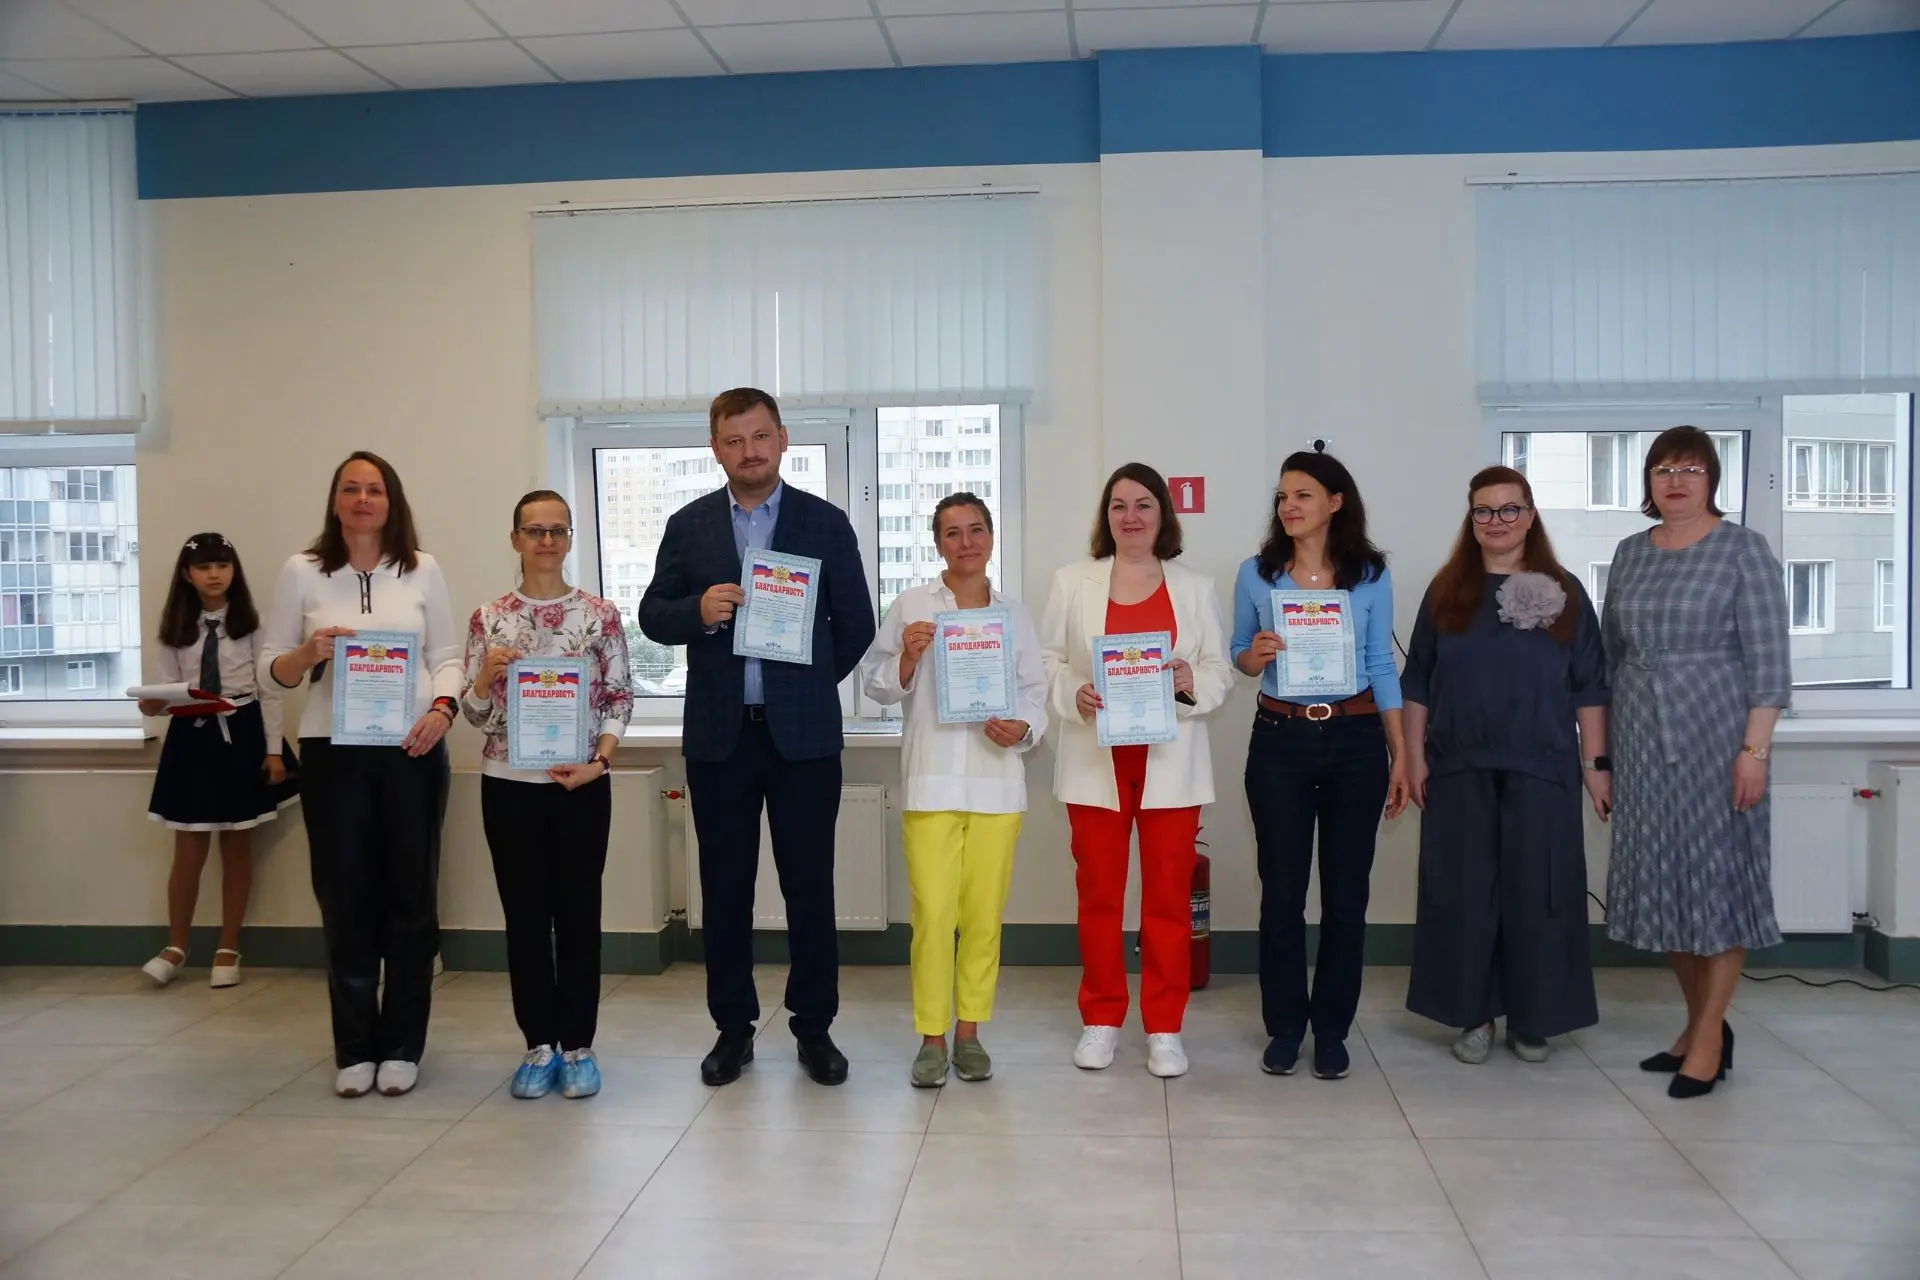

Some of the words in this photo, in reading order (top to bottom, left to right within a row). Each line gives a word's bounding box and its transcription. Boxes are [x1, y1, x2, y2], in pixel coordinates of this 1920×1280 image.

[755, 581, 805, 597] БЛАГОДАРНОСТЬ
[1288, 617, 1340, 626] БЛАГОДАРНОСТЬ
[949, 640, 1001, 651] БЛАГОДАРНОСТЬ
[350, 663, 404, 674] БЛАГОДАРНОСТЬ
[1107, 665, 1160, 676] БЛАГОДАРНОСТЬ
[522, 689, 576, 699] БЛАГОДАРНОСТЬ
